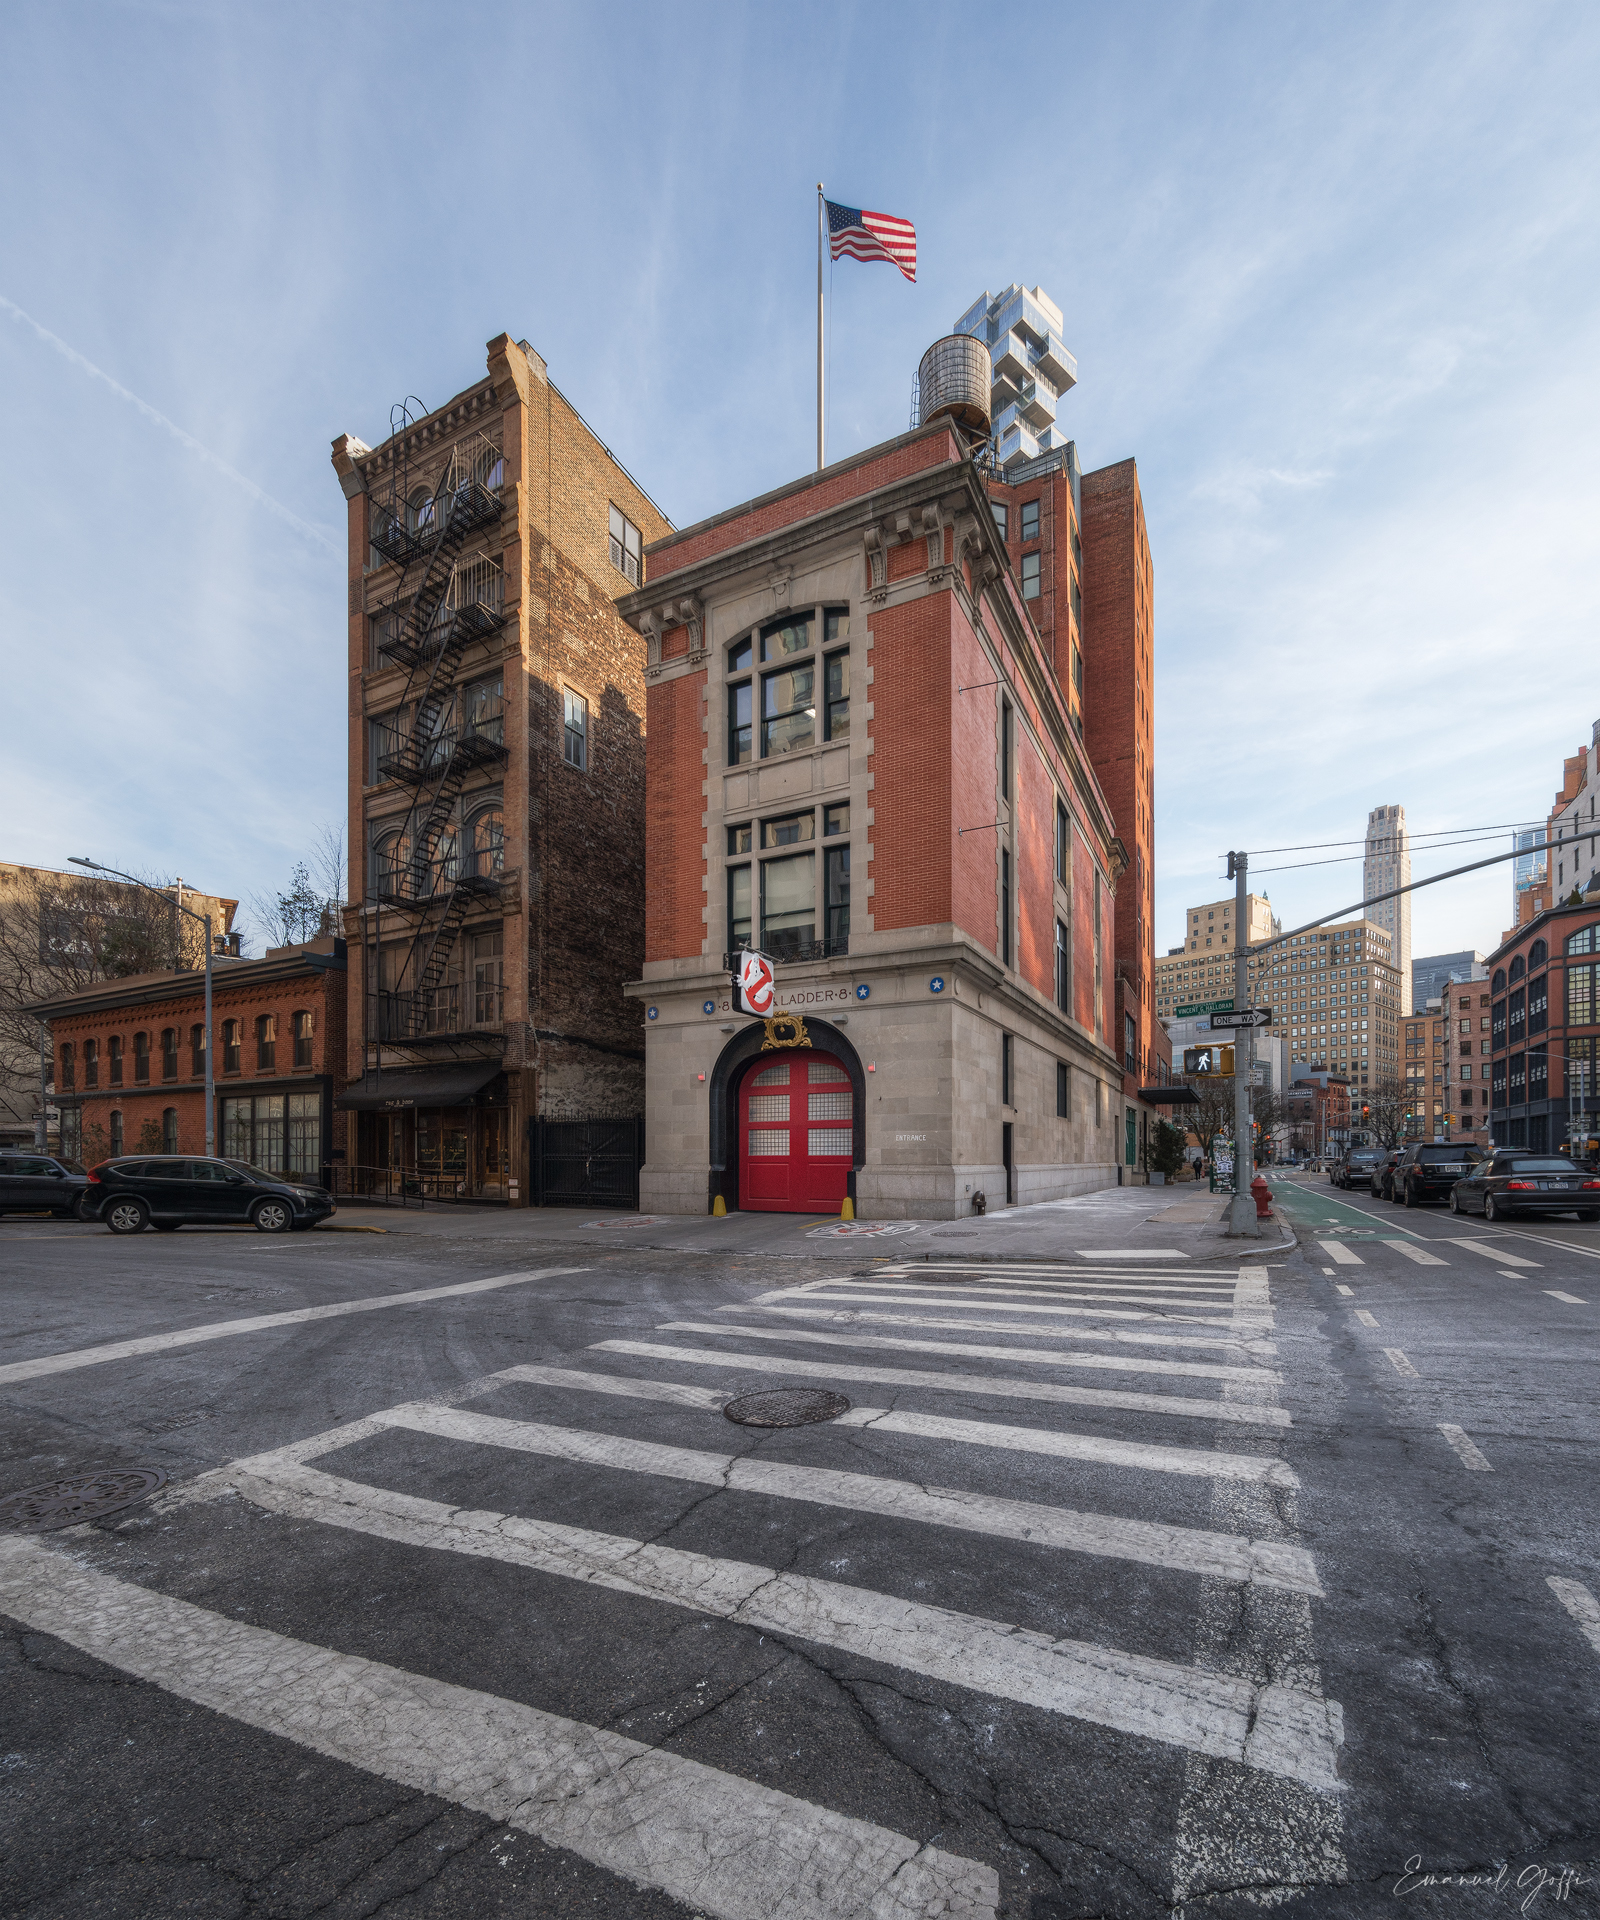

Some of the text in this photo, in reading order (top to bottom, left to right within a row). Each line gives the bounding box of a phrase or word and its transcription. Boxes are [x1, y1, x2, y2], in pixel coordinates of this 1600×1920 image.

[781, 990, 834, 1006] LADDER
[1177, 1006, 1199, 1015] VINCENT
[1205, 1002, 1233, 1011] HALLORAN
[1216, 1014, 1260, 1025] ONE WAY
[895, 1134, 927, 1142] ENTRANCE
